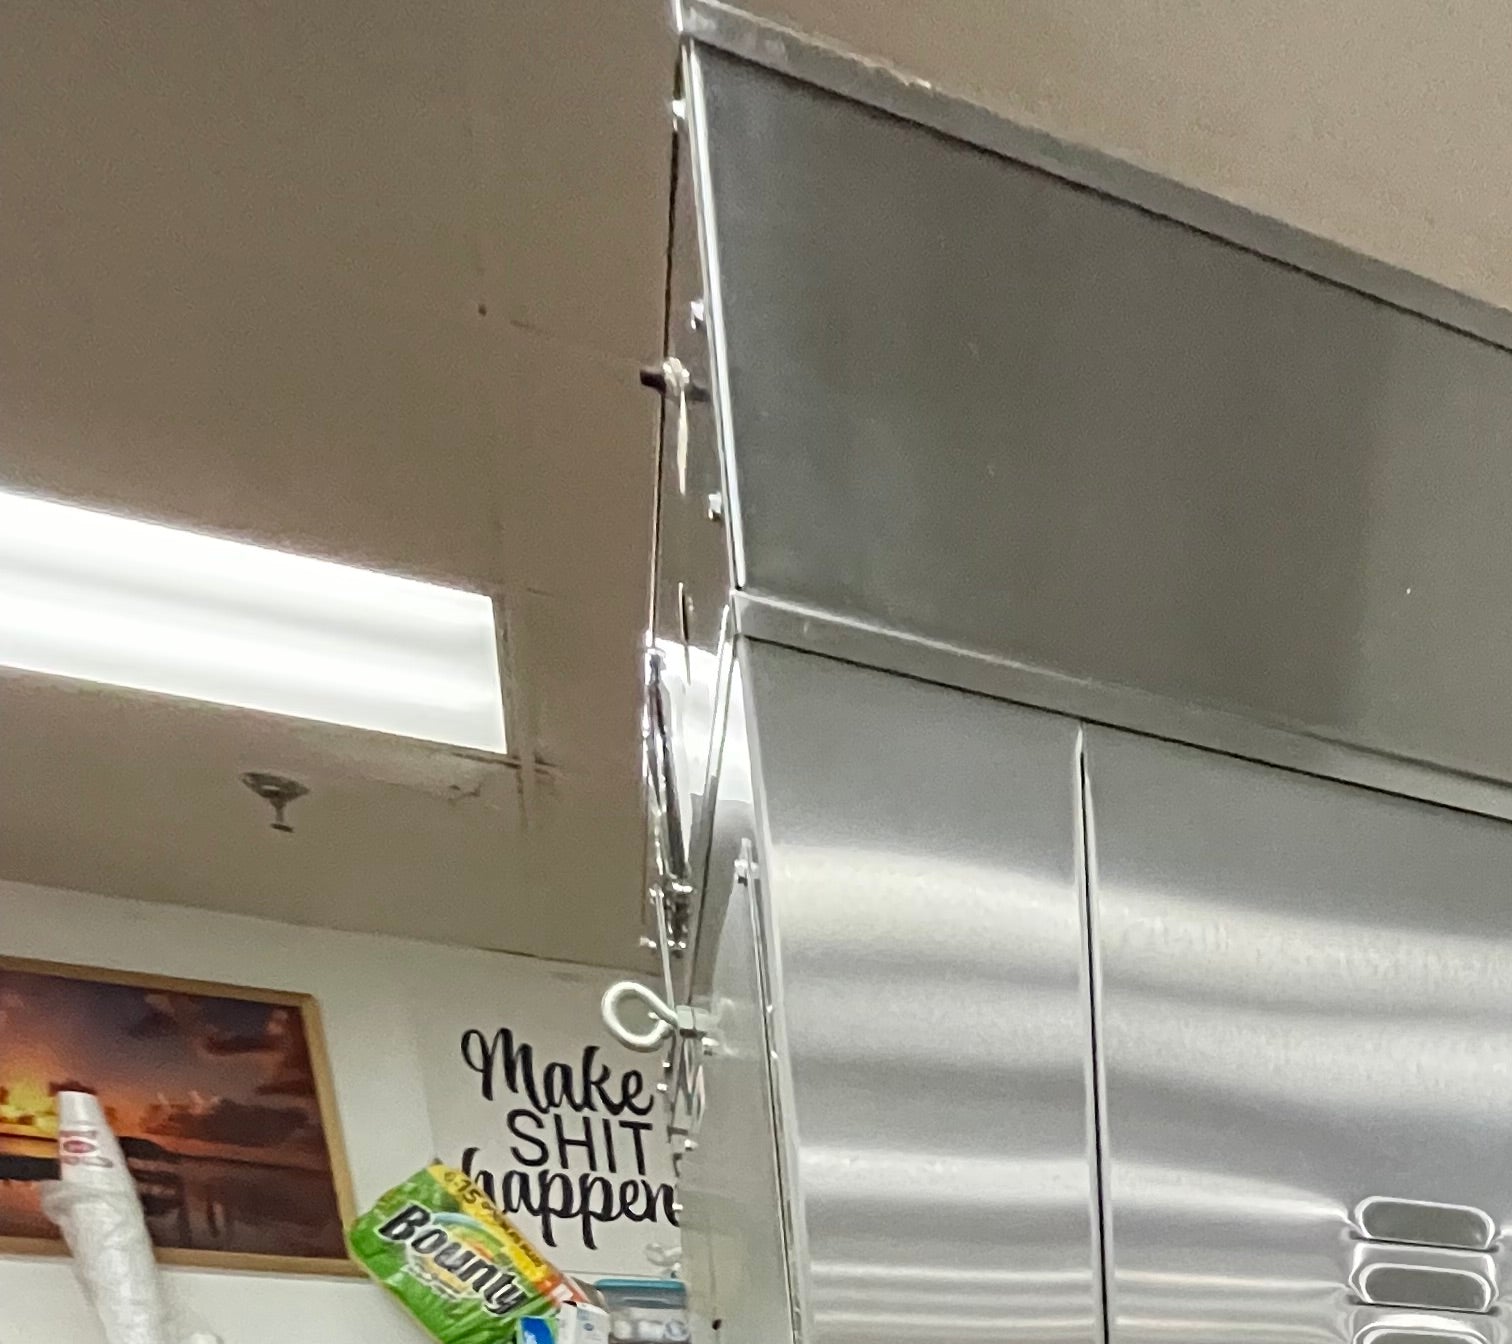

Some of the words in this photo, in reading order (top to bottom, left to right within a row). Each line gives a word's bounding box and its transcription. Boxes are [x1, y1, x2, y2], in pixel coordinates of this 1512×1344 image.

[461, 1027, 654, 1116] Make
[507, 1108, 653, 1176] SHIT
[378, 1204, 529, 1316] Bounty
